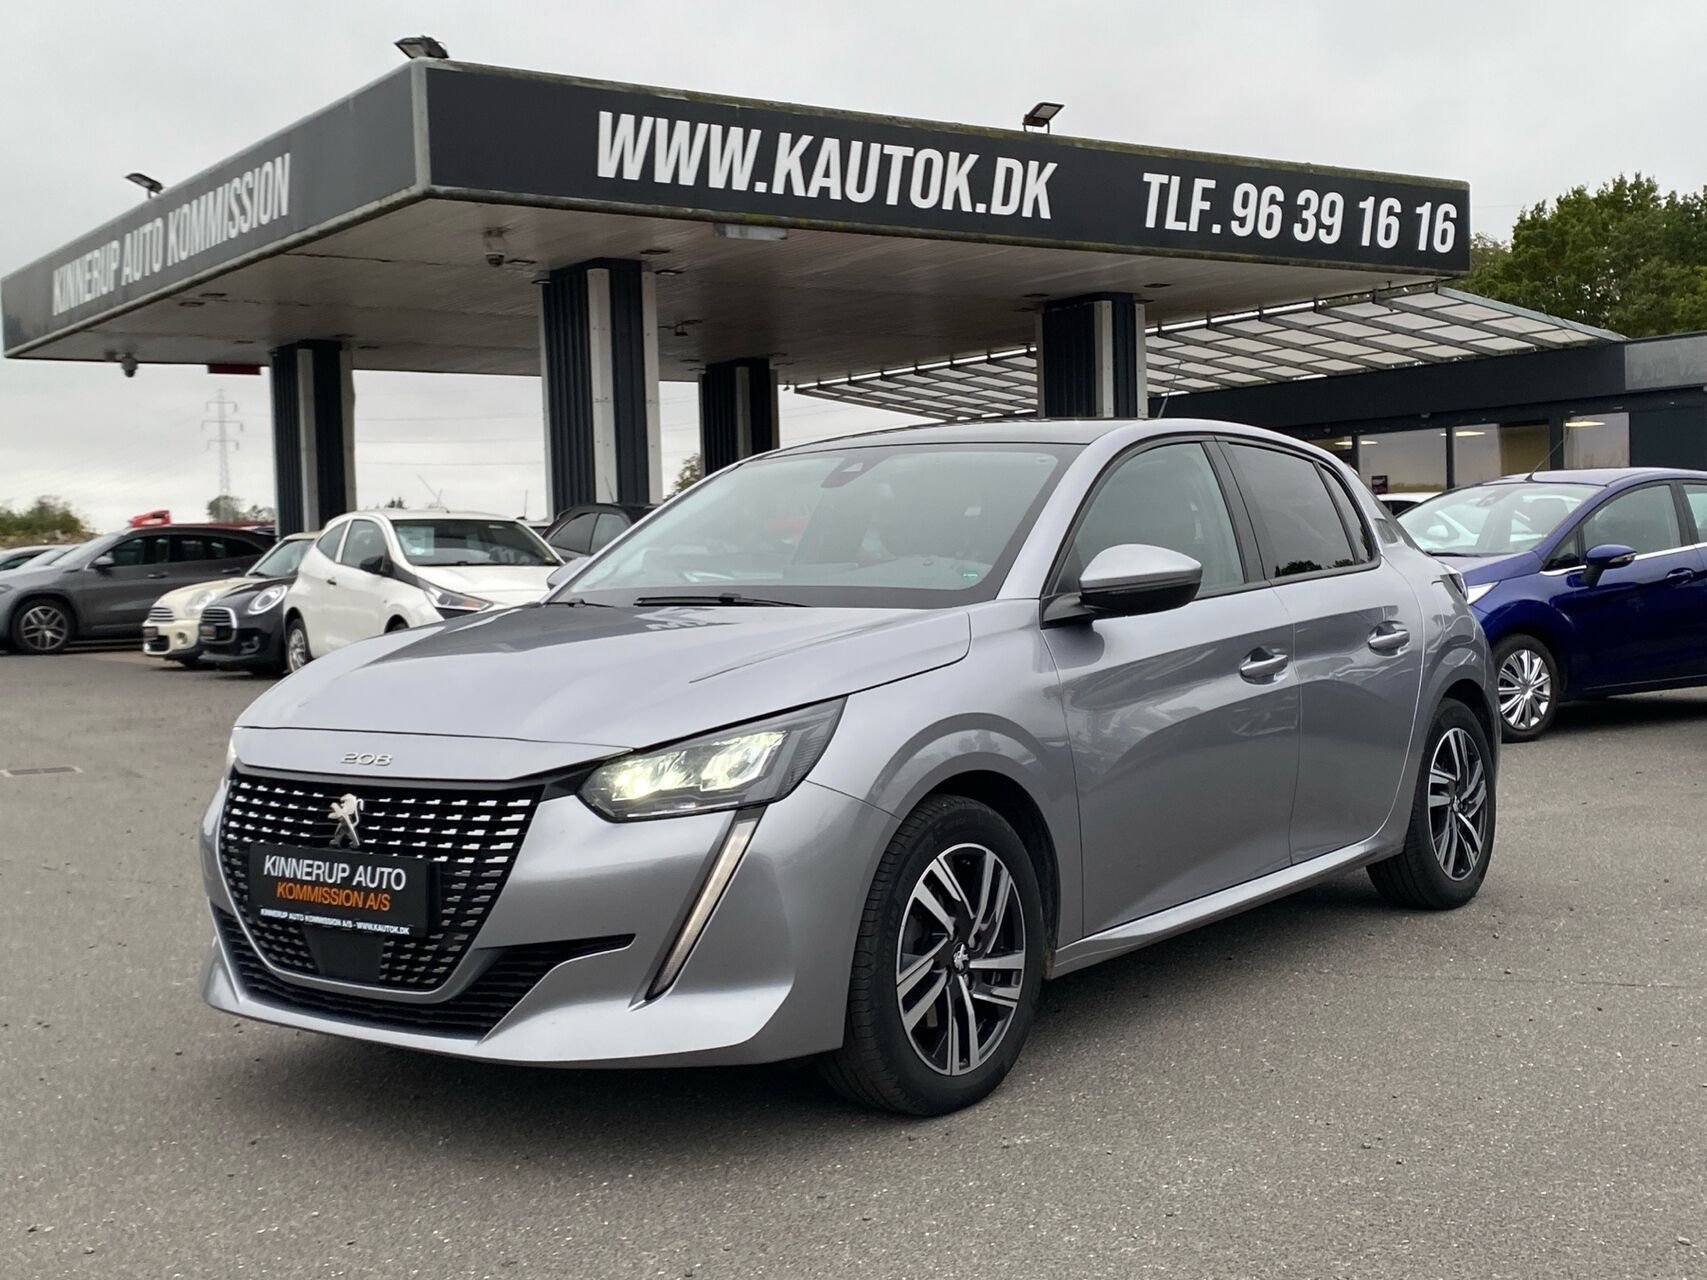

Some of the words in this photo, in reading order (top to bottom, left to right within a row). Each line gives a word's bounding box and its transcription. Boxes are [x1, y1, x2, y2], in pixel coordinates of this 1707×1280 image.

[597, 111, 1058, 220] WWW.KAUTOK.DK
[1142, 172, 1222, 235] TLF.
[1230, 182, 1286, 240] 96
[1293, 188, 1345, 246] 39
[1358, 195, 1402, 250] 16
[1416, 201, 1458, 254] 16
[52, 240, 121, 317] KINNERUP
[120, 217, 164, 287] AUTO
[166, 152, 291, 267] KOMMISSION
[340, 752, 392, 766] 208
[264, 855, 349, 883] KINNERUP
[353, 866, 406, 891] AUTO
[277, 882, 363, 907] KOMMISSION
[366, 893, 391, 911] A/S
[261, 908, 288, 919] KINNERUP
[288, 913, 305, 922] AUTO
[305, 915, 342, 927] KOMMISSION
